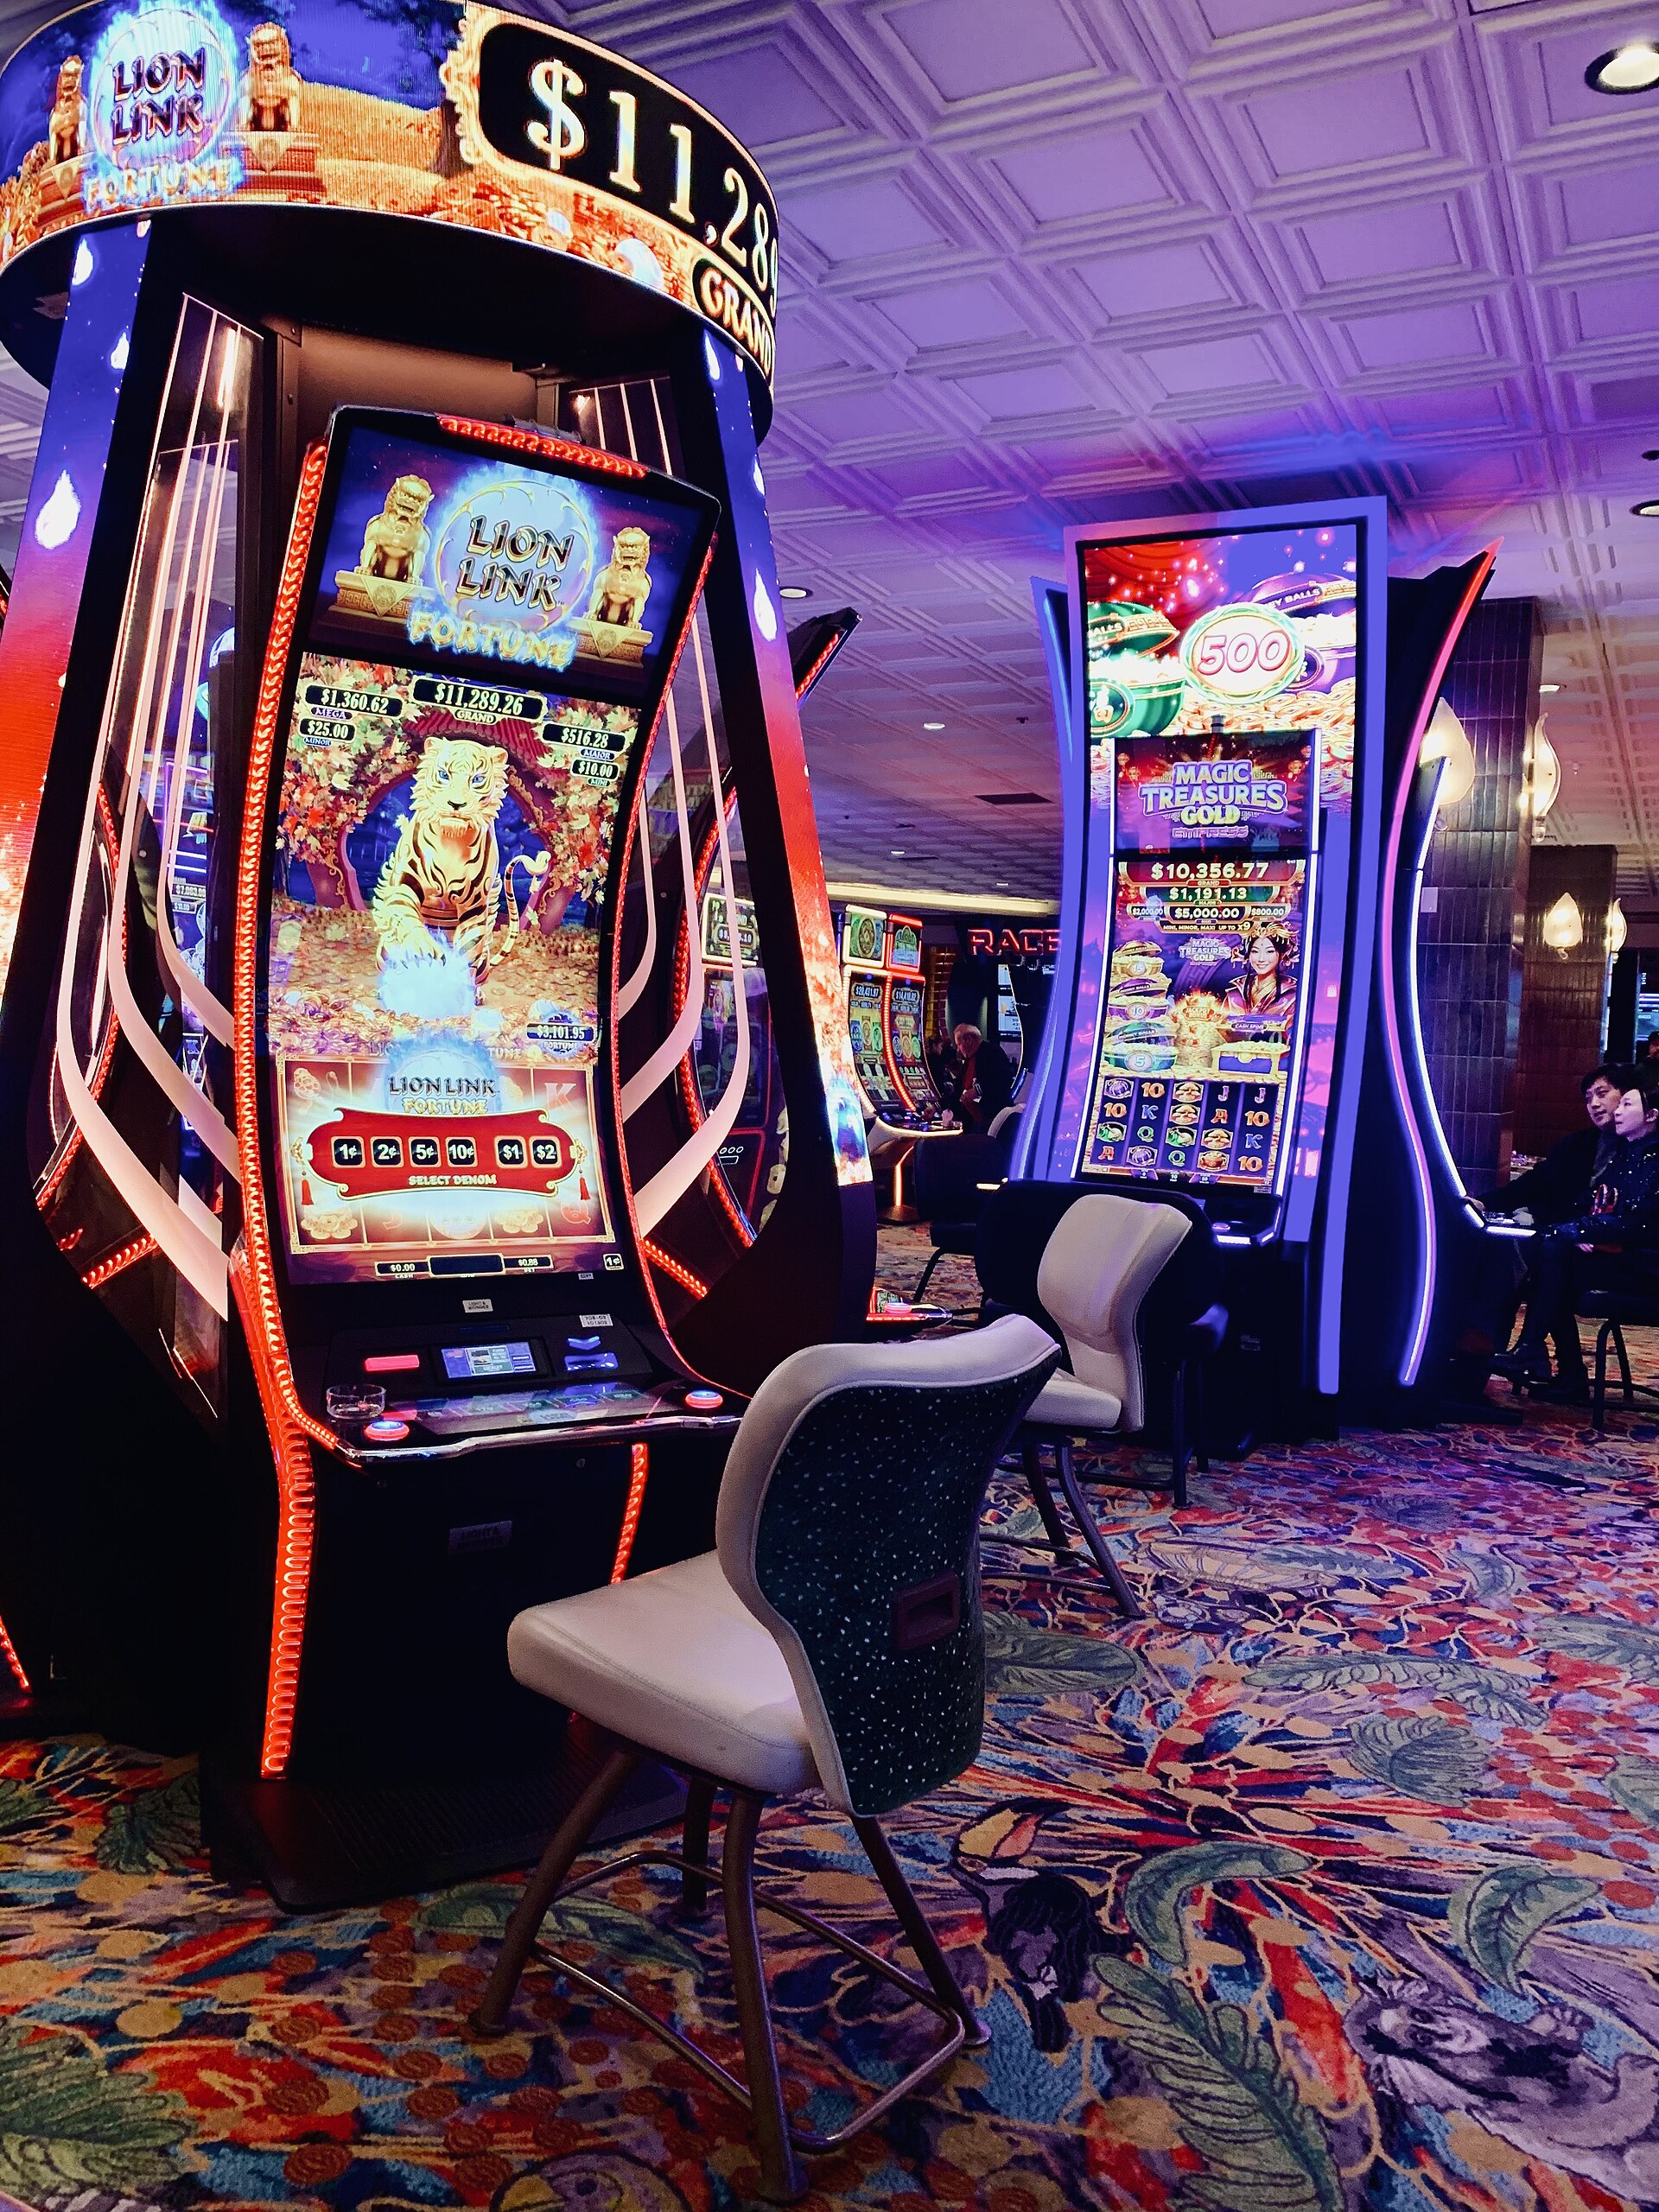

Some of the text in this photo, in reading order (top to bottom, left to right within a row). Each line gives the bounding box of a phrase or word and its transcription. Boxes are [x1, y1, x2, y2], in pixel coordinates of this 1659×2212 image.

[113, 47, 207, 102] LION
[111, 94, 204, 145] LINK
[88, 158, 231, 209] FORTUNE
[701, 265, 772, 377] GRAND
[467, 515, 574, 572] LION
[456, 556, 562, 612] LINK
[1284, 588, 1320, 603] BALLS
[410, 610, 575, 668] FORTUNE
[1198, 630, 1290, 675] 500
[321, 688, 390, 715] $1,360.62
[435, 683, 524, 715] $11,289.26
[315, 707, 346, 719] MEGA
[457, 711, 495, 724] GRAND
[307, 720, 349, 739] $25.00
[304, 737, 330, 747] MINOR
[562, 728, 609, 748] $516.28
[584, 750, 611, 760] MAJOR
[578, 760, 613, 778] $10.00
[1176, 763, 1249, 785] MAGIC
[1141, 784, 1286, 812] TREASURES
[1180, 805, 1241, 825] GOLD
[1173, 826, 1249, 839] EMPRESS
[1151, 862, 1269, 880] $10,356.77
[1169, 887, 1248, 901] $1,191.13
[1175, 907, 1240, 919] $5,000.00
[1179, 947, 1231, 957] TREASURES
[537, 1025, 585, 1039] $3,101.95
[1135, 1055, 1147, 1067] 5
[389, 1077, 497, 1097] LION LINK
[1141, 1082, 1165, 1098] 10
[1217, 1085, 1230, 1102] J
[1254, 1087, 1266, 1103] J
[403, 1097, 488, 1115] FORTUNE
[1103, 1103, 1127, 1118] 10
[1141, 1104, 1159, 1120] K
[1211, 1109, 1228, 1124] A
[1244, 1111, 1270, 1127] 10
[1137, 1126, 1154, 1142] Q
[1245, 1134, 1263, 1149] K
[340, 1143, 555, 1161] 1¢ 2¢ 5¢ 10¢ $1 $2
[1098, 1146, 1114, 1160] A
[1168, 1150, 1185, 1166] Q
[1237, 1155, 1263, 1172] 10
[408, 1173, 497, 1186] SELECT DENOM
[390, 1263, 416, 1273] $0.00
[606, 1256, 620, 1266] 1¢
